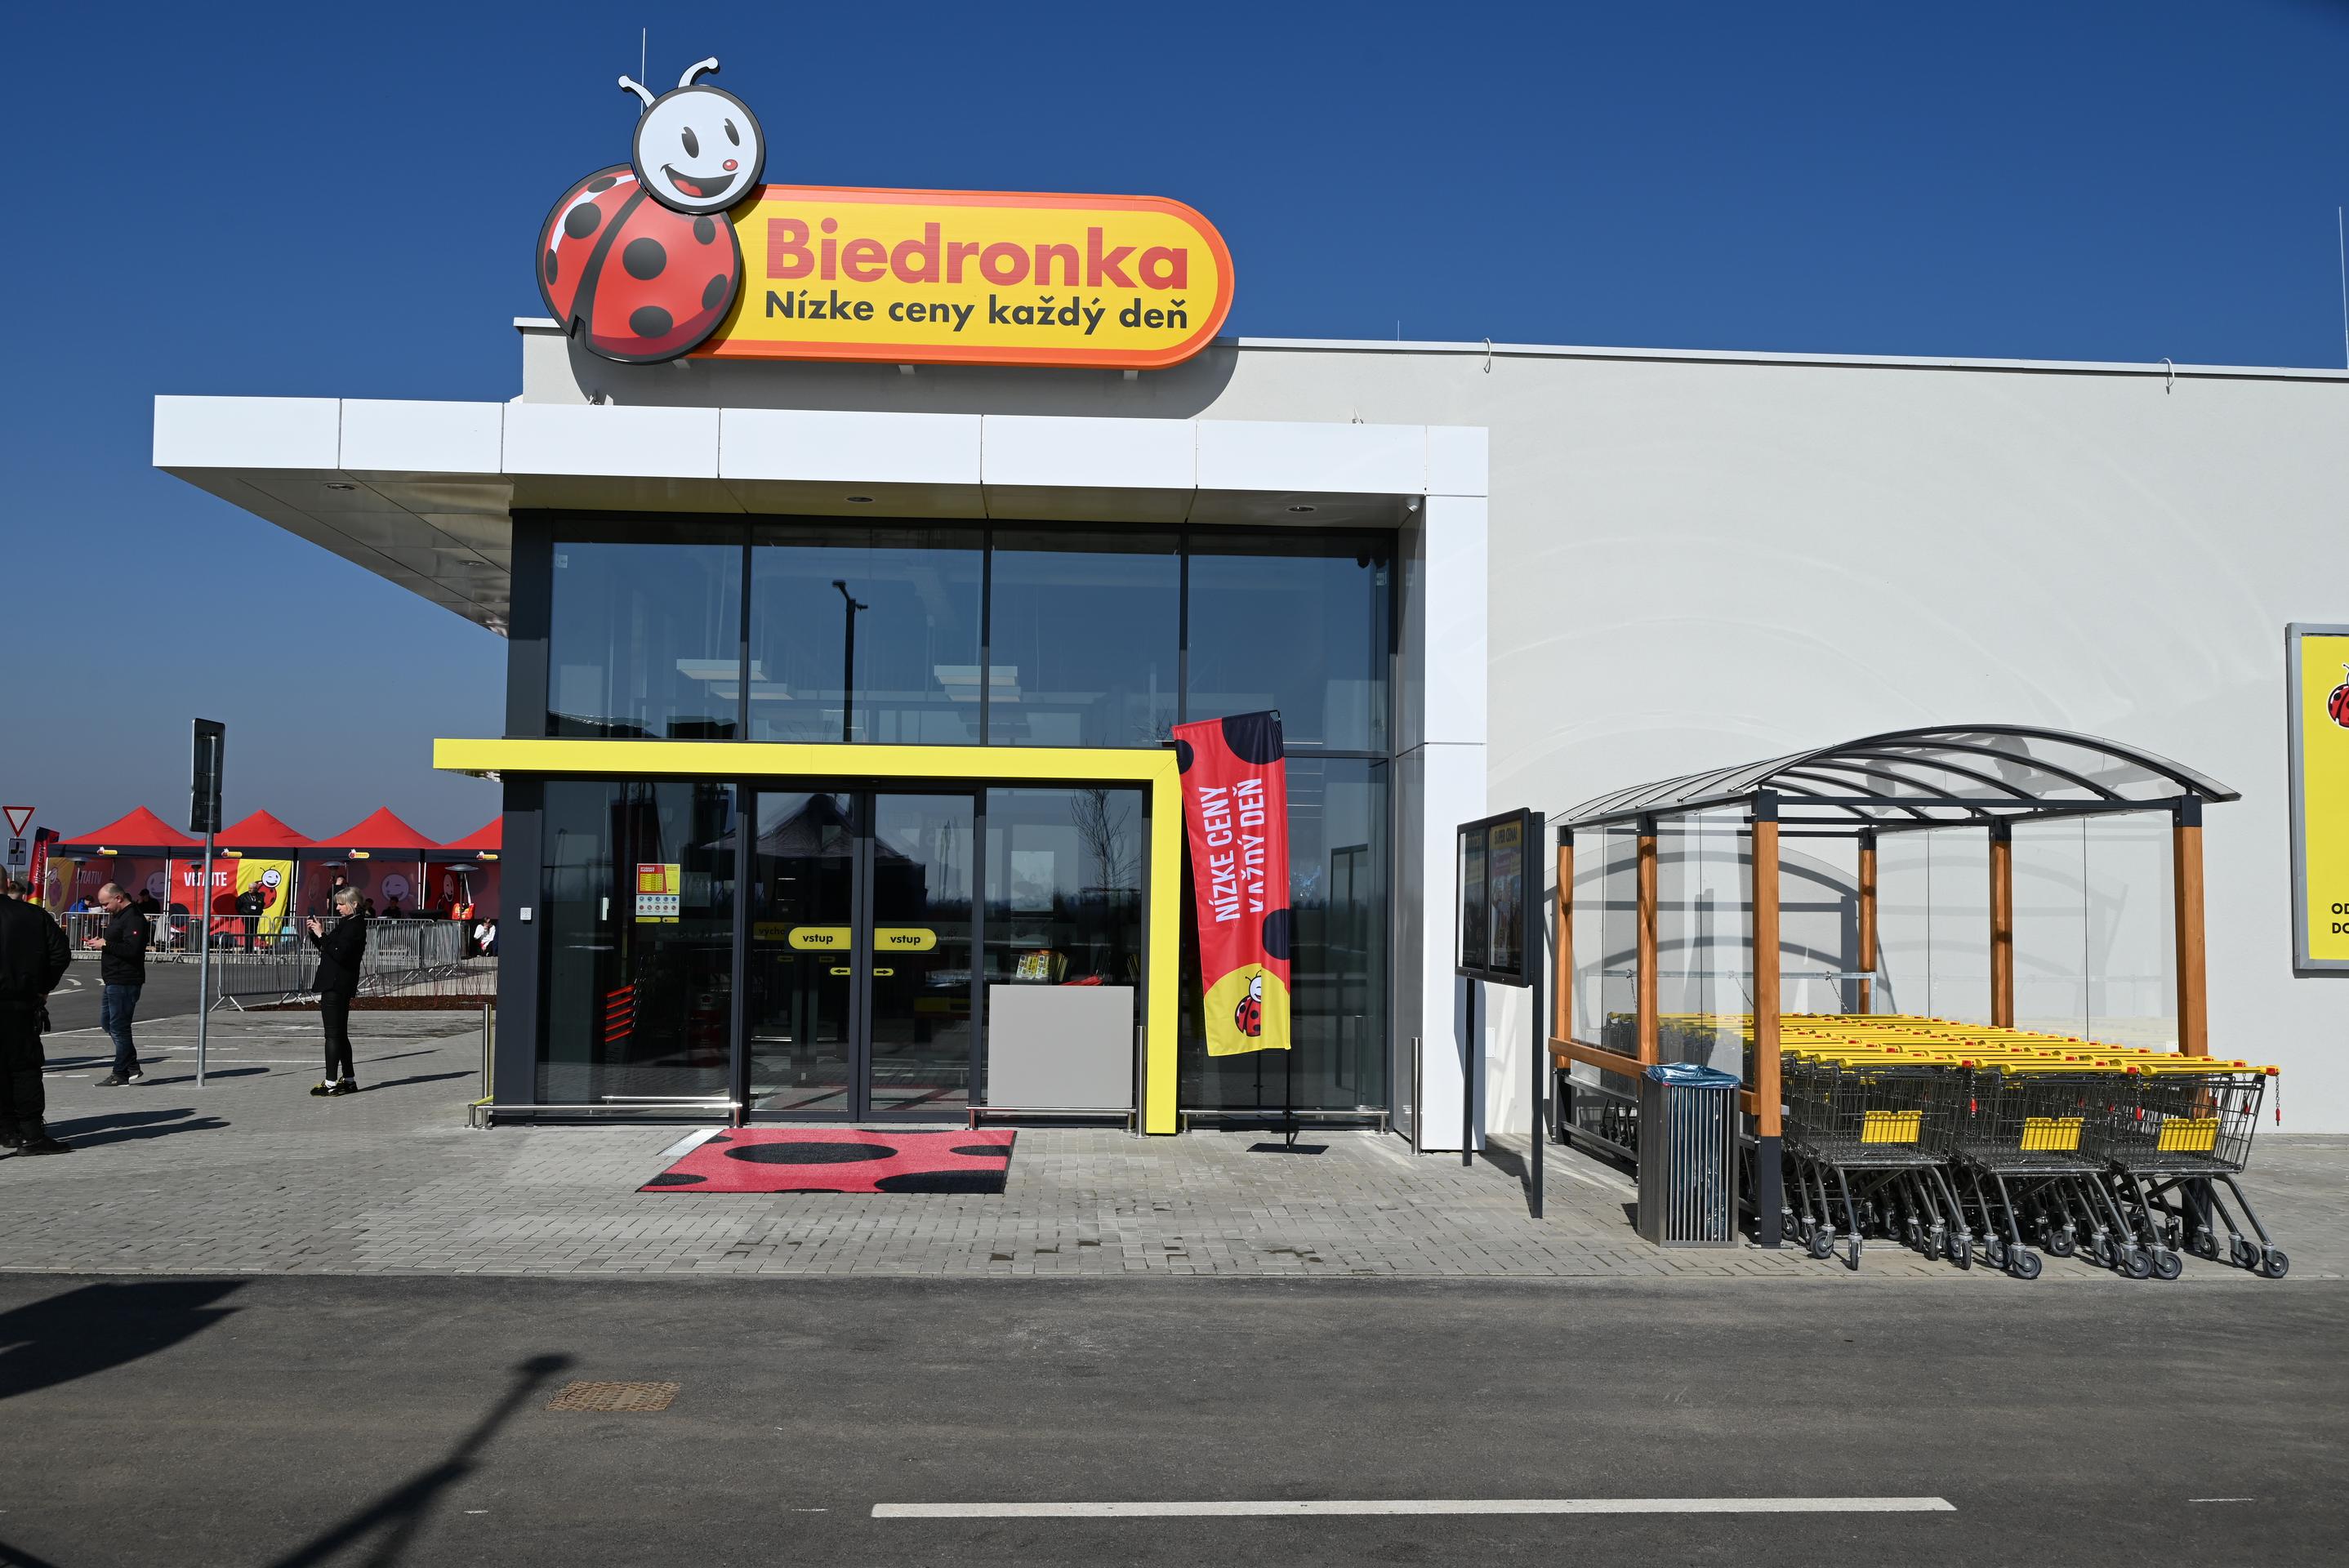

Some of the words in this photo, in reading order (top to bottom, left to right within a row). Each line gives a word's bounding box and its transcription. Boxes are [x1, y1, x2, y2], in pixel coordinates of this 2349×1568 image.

[766, 217, 1188, 290] Biedronka
[765, 289, 874, 321] Nízke
[889, 302, 975, 332] ceny
[989, 294, 1106, 335] každý
[1119, 298, 1188, 328] deň
[1198, 786, 1232, 847] CENY
[1232, 778, 1264, 827] DEŇ
[1209, 850, 1240, 922] NÍZKE
[803, 933, 833, 945] vstup
[890, 934, 920, 946] vstup
